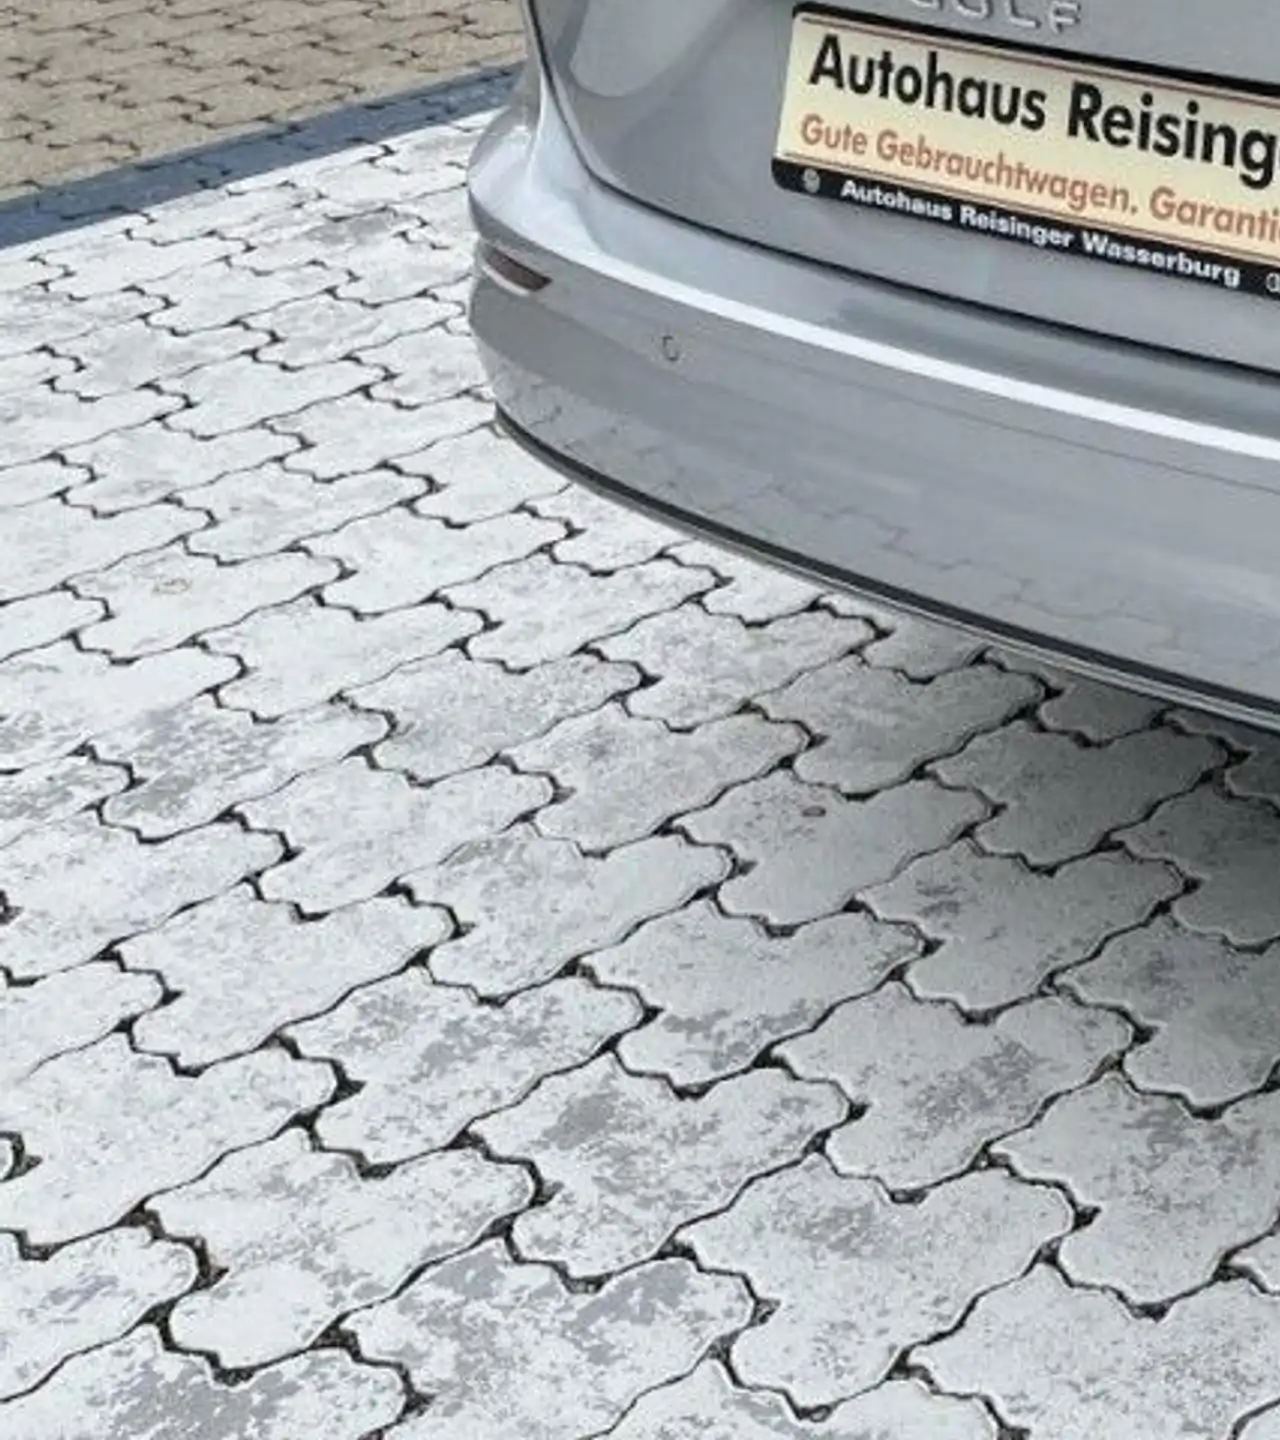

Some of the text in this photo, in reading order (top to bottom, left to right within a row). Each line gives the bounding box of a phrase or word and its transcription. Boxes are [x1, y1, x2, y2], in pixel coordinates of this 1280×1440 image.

[808, 34, 1048, 131] Autohaus
[800, 113, 869, 156] Gute
[876, 128, 1139, 216] Gebrauchtwagen.
[840, 179, 953, 221] Autohaus
[958, 204, 1075, 248] Reisinger
[1081, 230, 1242, 289] Wasserburg
